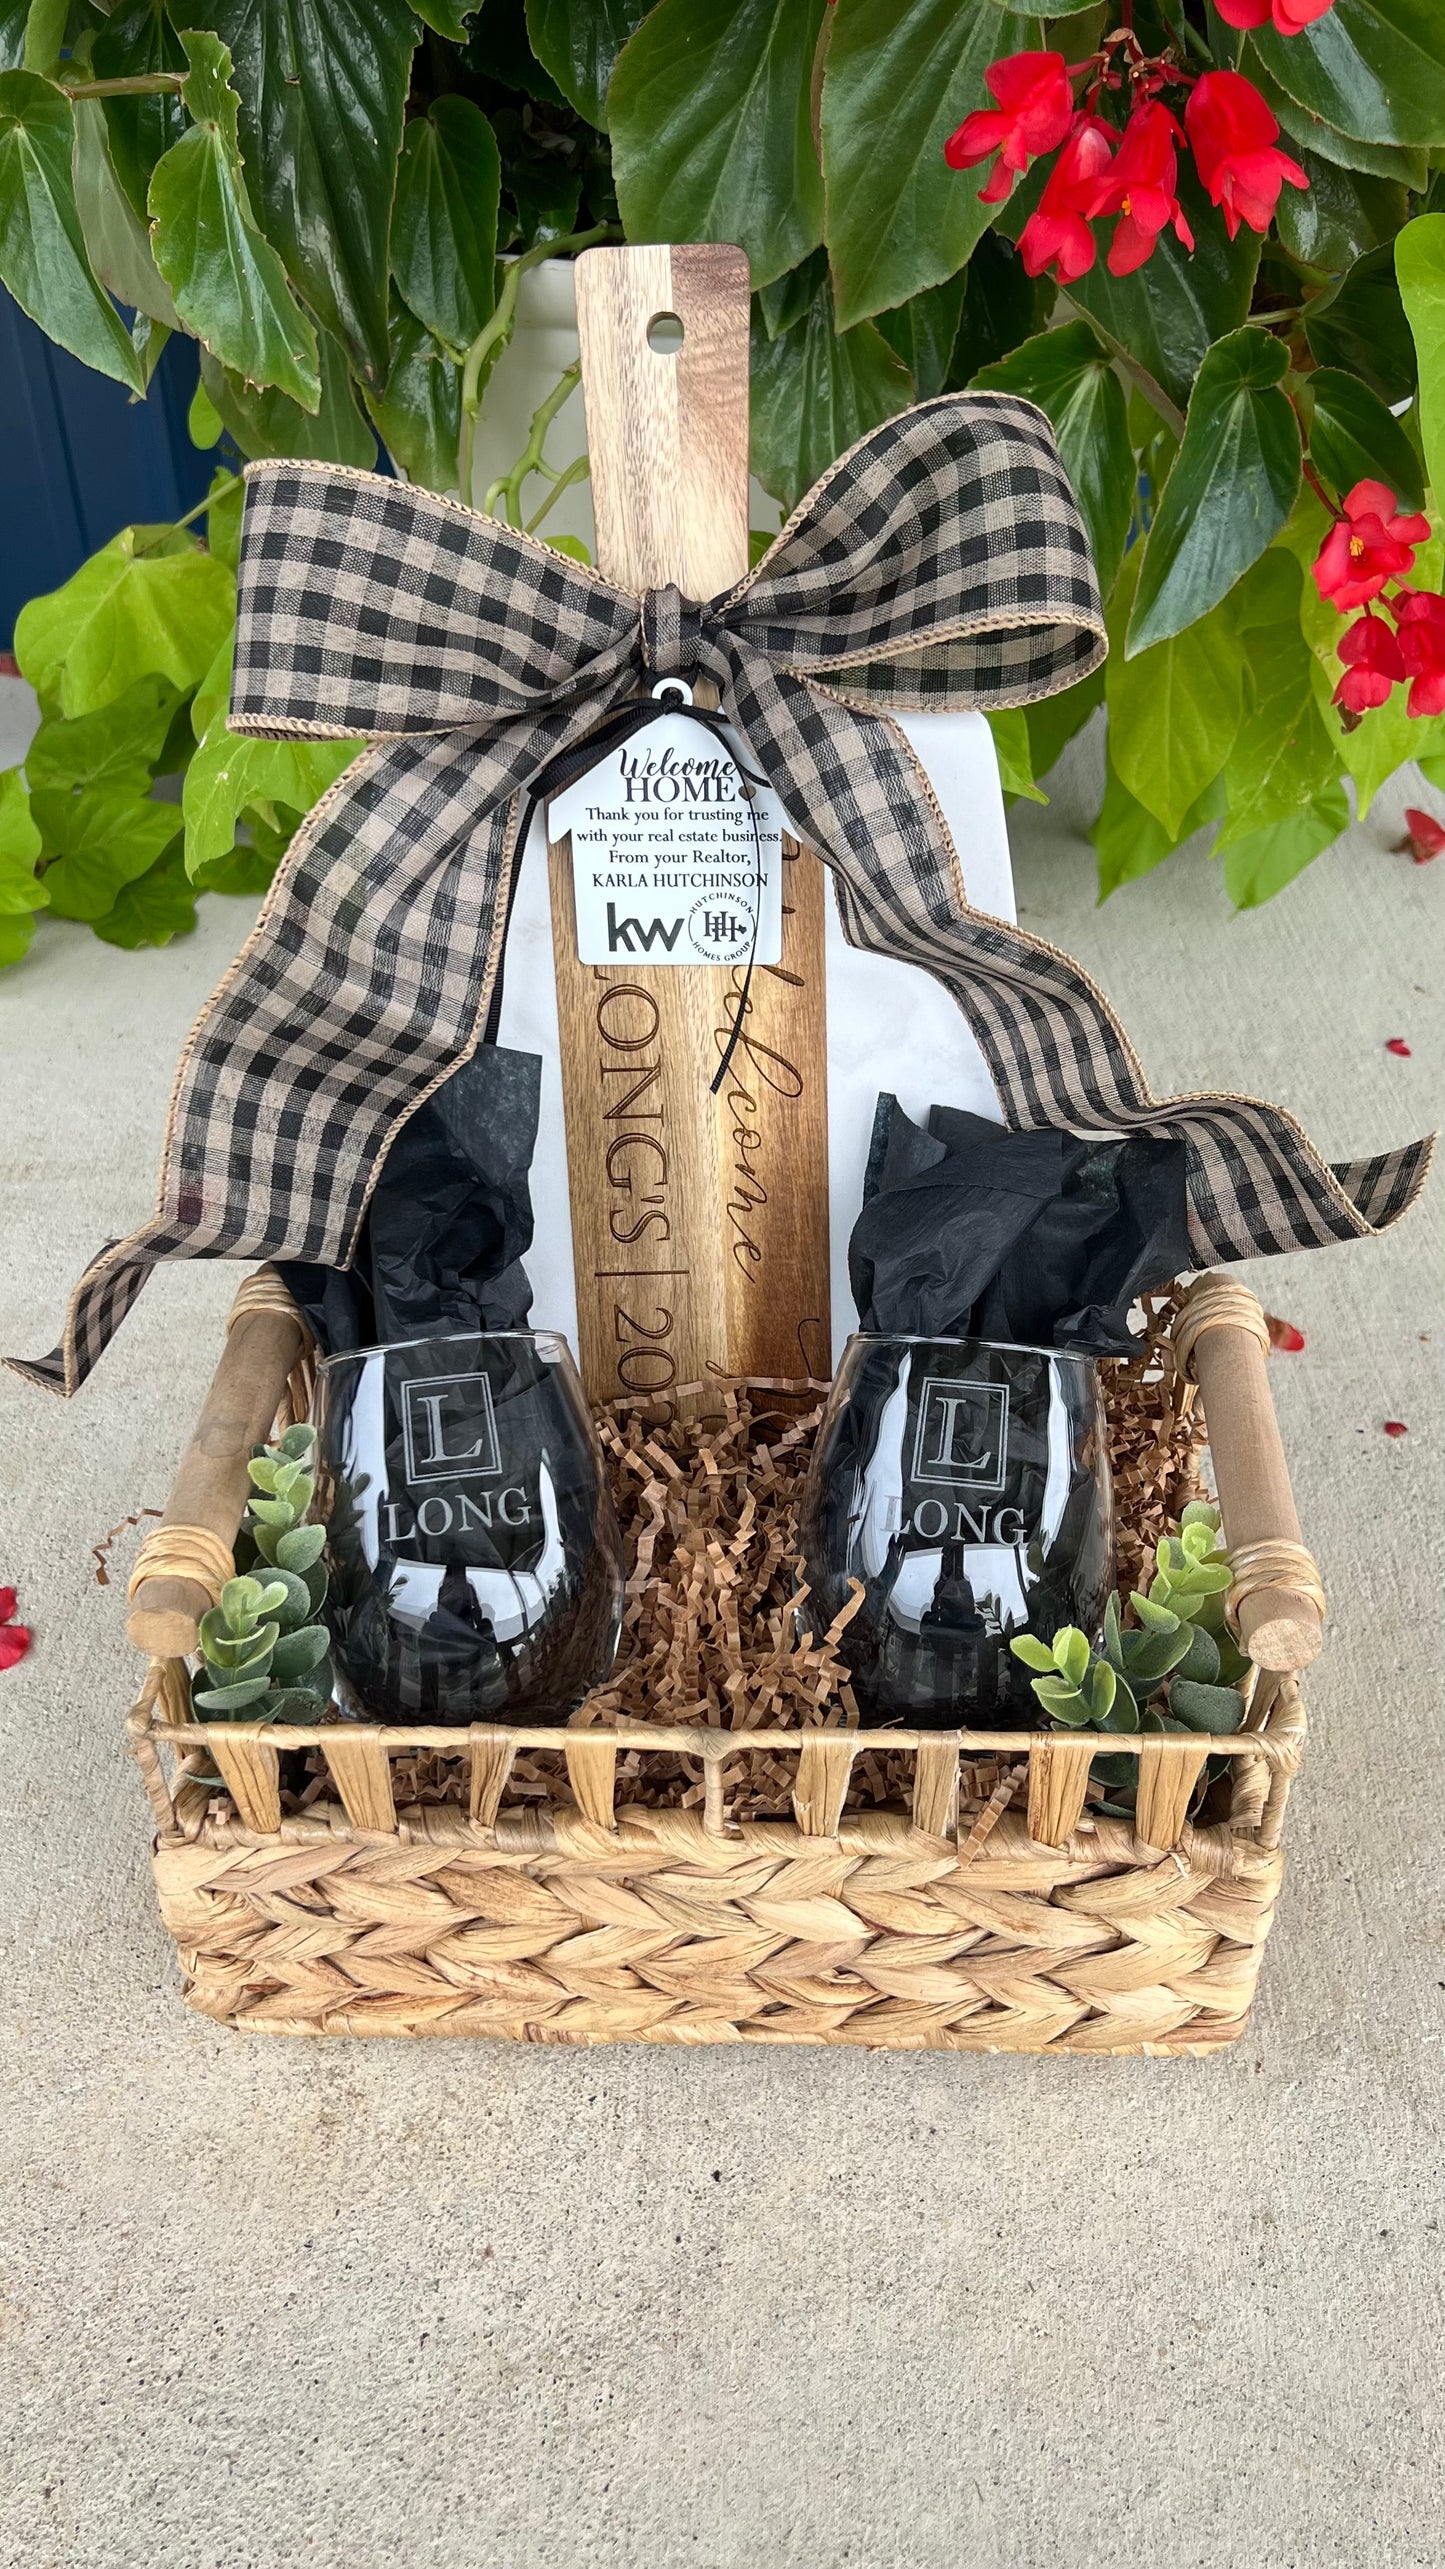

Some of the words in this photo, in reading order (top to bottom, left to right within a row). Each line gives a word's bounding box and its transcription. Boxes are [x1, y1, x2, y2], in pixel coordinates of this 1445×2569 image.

[618, 747, 738, 780] Welcome
[624, 776, 736, 802] HOME
[585, 807, 629, 821] Thank
[634, 811, 659, 826] you
[664, 807, 684, 821] for
[689, 808, 743, 826] trusting
[748, 810, 769, 821] me
[577, 828, 608, 842] with
[612, 832, 644, 847] your
[648, 828, 674, 842] real
[678, 830, 718, 842] estate
[722, 828, 783, 842] business.
[609, 850, 649, 864] From
[654, 853, 688, 869] your
[693, 849, 752, 867] Realtor,
[592, 873, 649, 888] KARLA
[653, 873, 769, 888] HUTCHINSON
[689, 891, 754, 914] HUTCHINSON
[692, 941, 721, 962] HOMES
[723, 941, 751, 962] GROUP
[594, 965, 671, 1244] ONG'S
[713, 965, 806, 1285] elcome
[416, 1394, 483, 1464] L
[927, 1396, 992, 1470] L
[383, 1486, 532, 1543] LONG
[879, 1494, 1028, 1546] LONG
